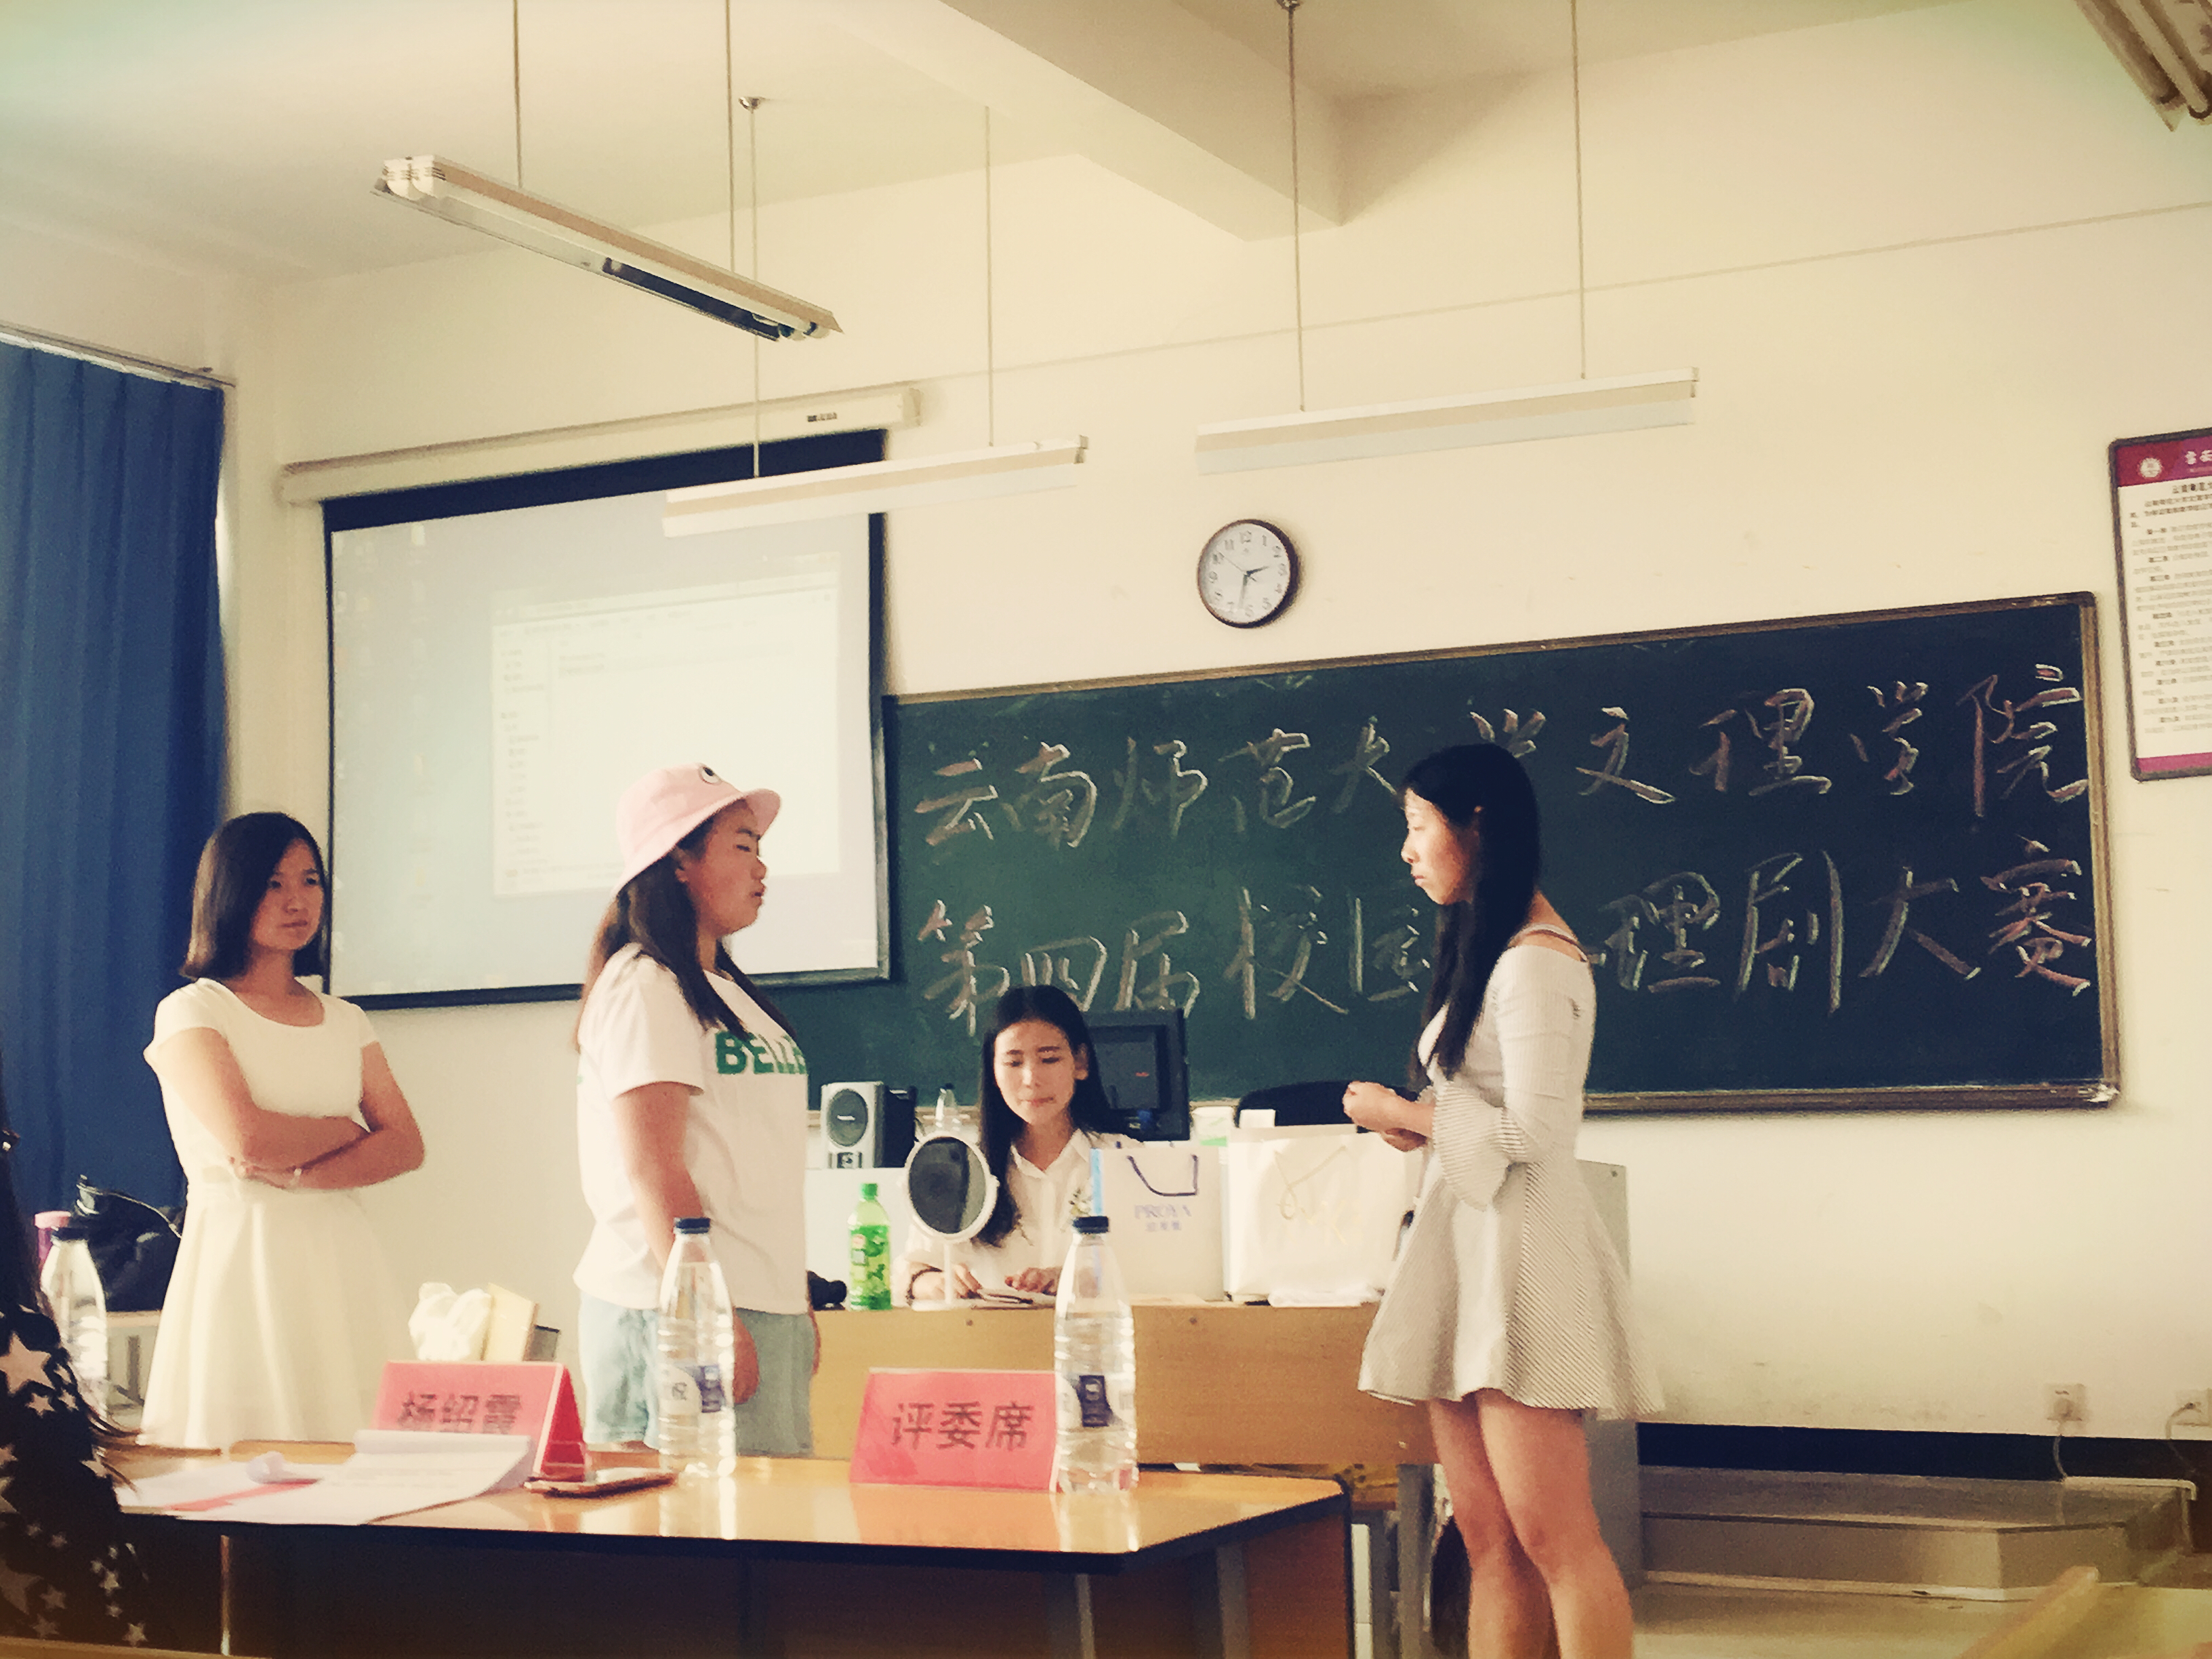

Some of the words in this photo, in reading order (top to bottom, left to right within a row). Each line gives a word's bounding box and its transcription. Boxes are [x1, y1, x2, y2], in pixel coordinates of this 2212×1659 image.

[917, 834, 2091, 1037] 第四届校园理剧大赛
[891, 1399, 1035, 1451] 评委席
